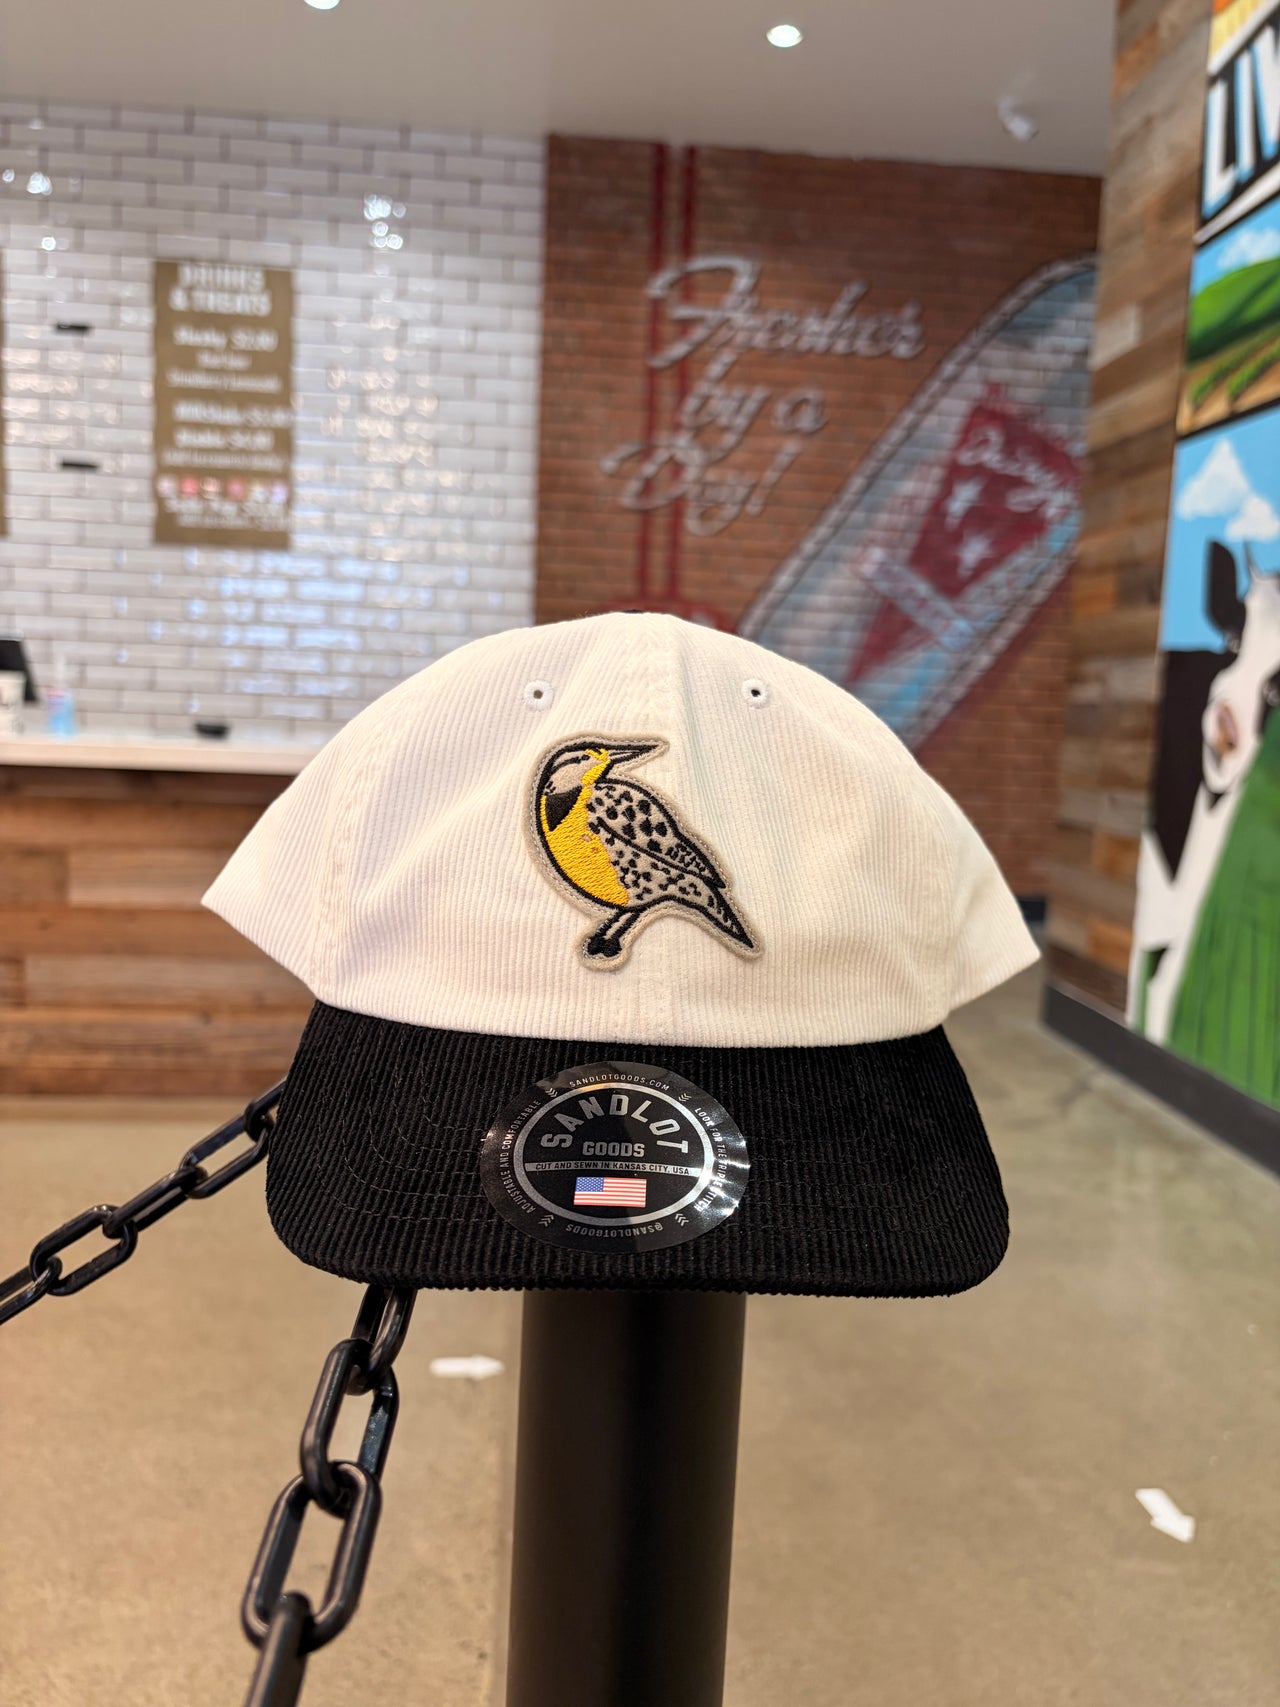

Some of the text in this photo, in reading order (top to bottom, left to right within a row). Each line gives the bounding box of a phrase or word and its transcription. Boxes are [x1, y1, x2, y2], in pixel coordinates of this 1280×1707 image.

[569, 1074, 670, 1091] SANDLOTGOODS.COM
[540, 1093, 689, 1154] SANDLOT
[694, 1107, 715, 1127] LOOK
[710, 1127, 723, 1142] FOR
[500, 1100, 541, 1213] ADJUSTABLE AND COMFORTABLE
[582, 1141, 645, 1158] GOODS
[716, 1144, 728, 1159] THE
[536, 1162, 551, 1170] CUT
[554, 1161, 572, 1169] AND
[574, 1161, 598, 1169] SEWN
[600, 1161, 610, 1169] IN
[612, 1162, 647, 1171] KANSAS
[672, 1166, 690, 1175] USA
[566, 1222, 664, 1238] @SANDLOTGOODS
